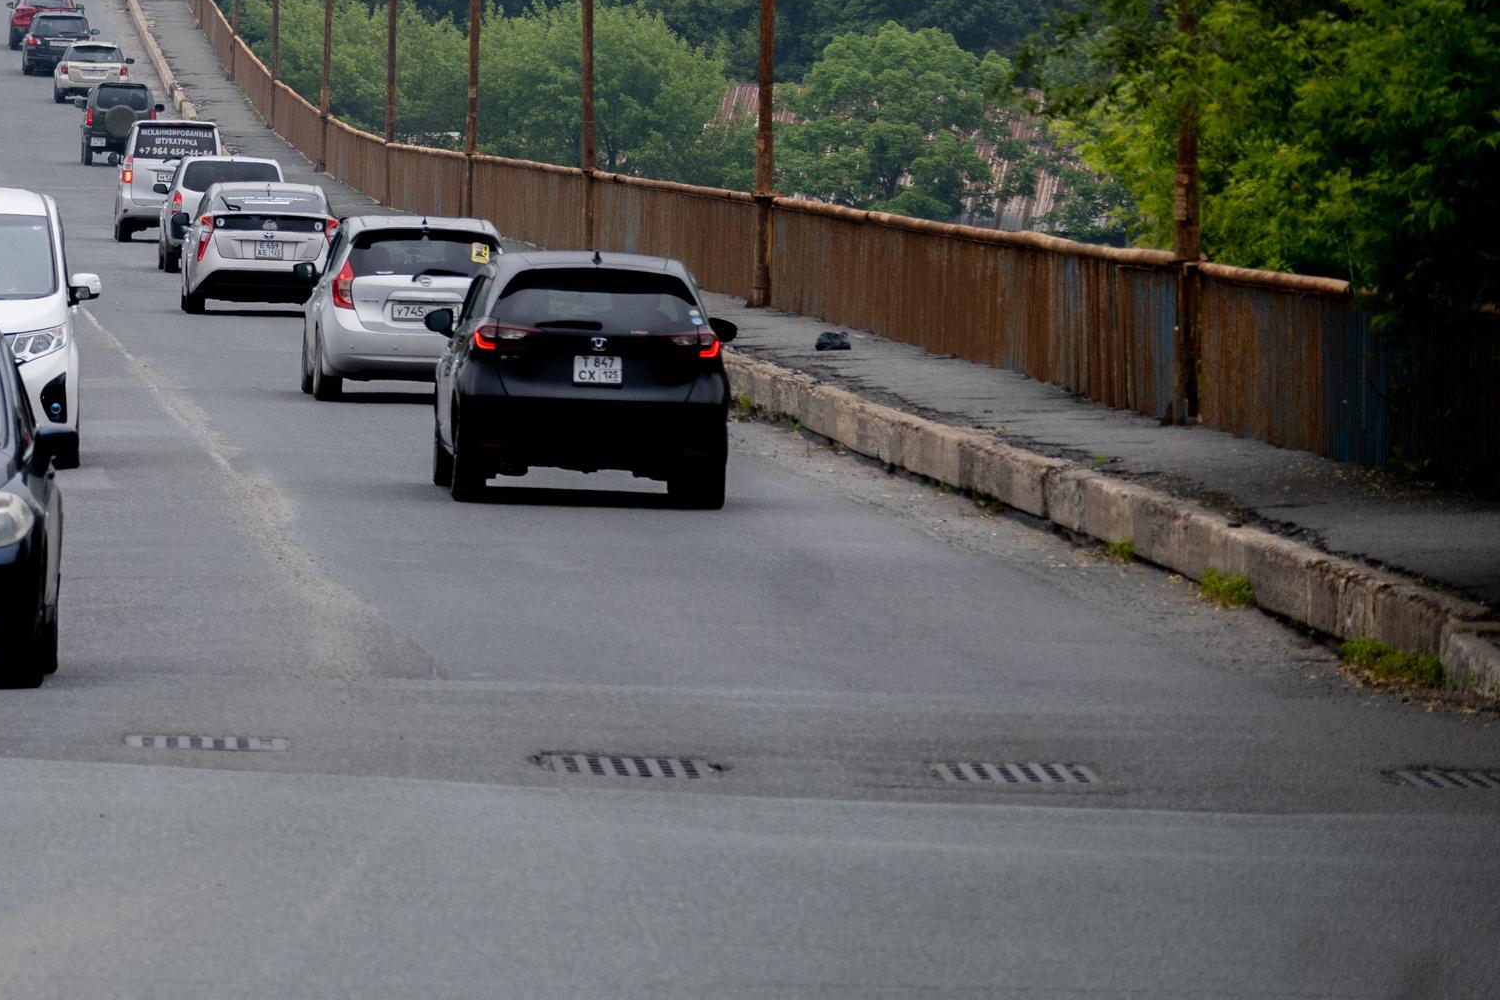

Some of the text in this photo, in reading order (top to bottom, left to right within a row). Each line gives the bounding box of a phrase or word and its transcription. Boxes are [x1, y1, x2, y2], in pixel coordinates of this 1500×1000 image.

[141, 128, 213, 138] МЕХАНИЗИРОВАННАЯ
[155, 137, 198, 146] ШТУКАТУРКА
[152, 147, 168, 155] 964
[582, 357, 615, 368] Т 847
[578, 370, 619, 381] СХ 125
